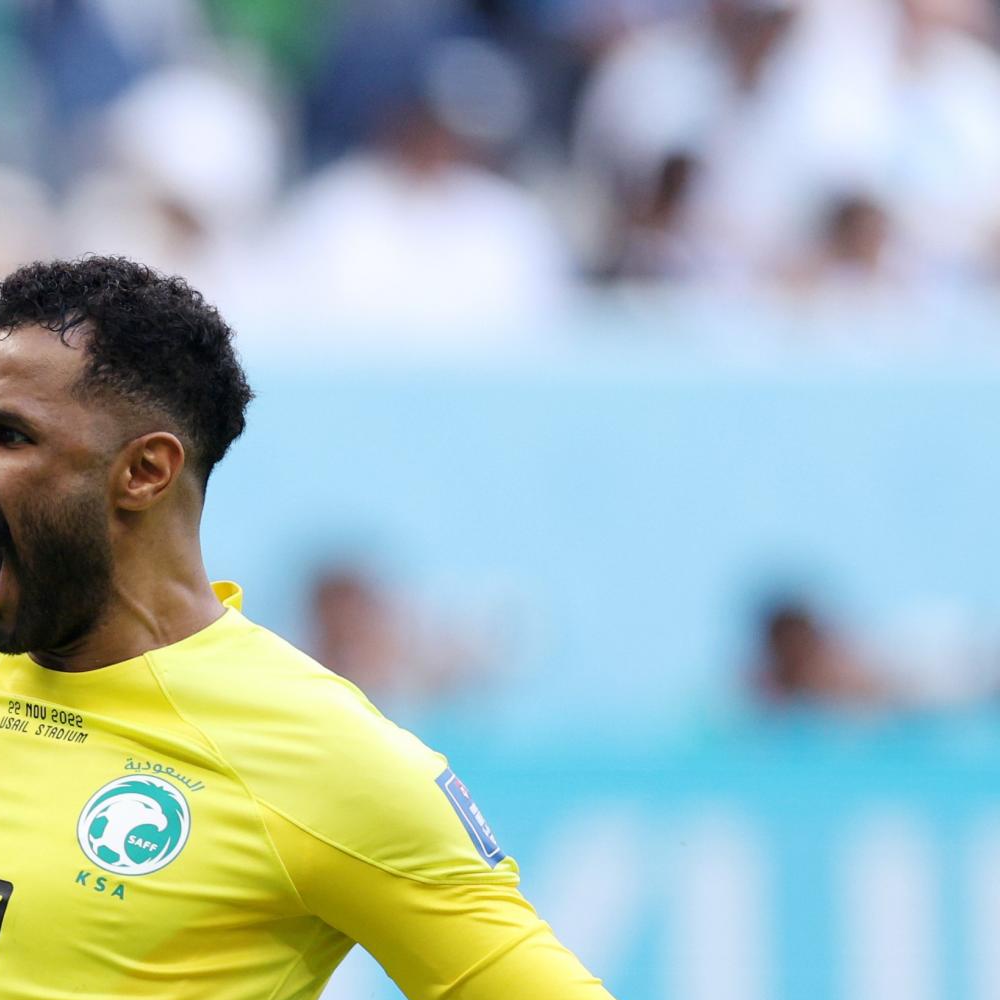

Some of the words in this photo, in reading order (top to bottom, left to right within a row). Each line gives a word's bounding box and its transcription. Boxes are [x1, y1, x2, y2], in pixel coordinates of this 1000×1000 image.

[8, 700, 21, 715] 22
[25, 702, 47, 720] NOV
[51, 708, 83, 728] 2022
[35, 723, 89, 744] STADIUM
[124, 757, 206, 792] السعودية
[127, 834, 159, 852] SAFF
